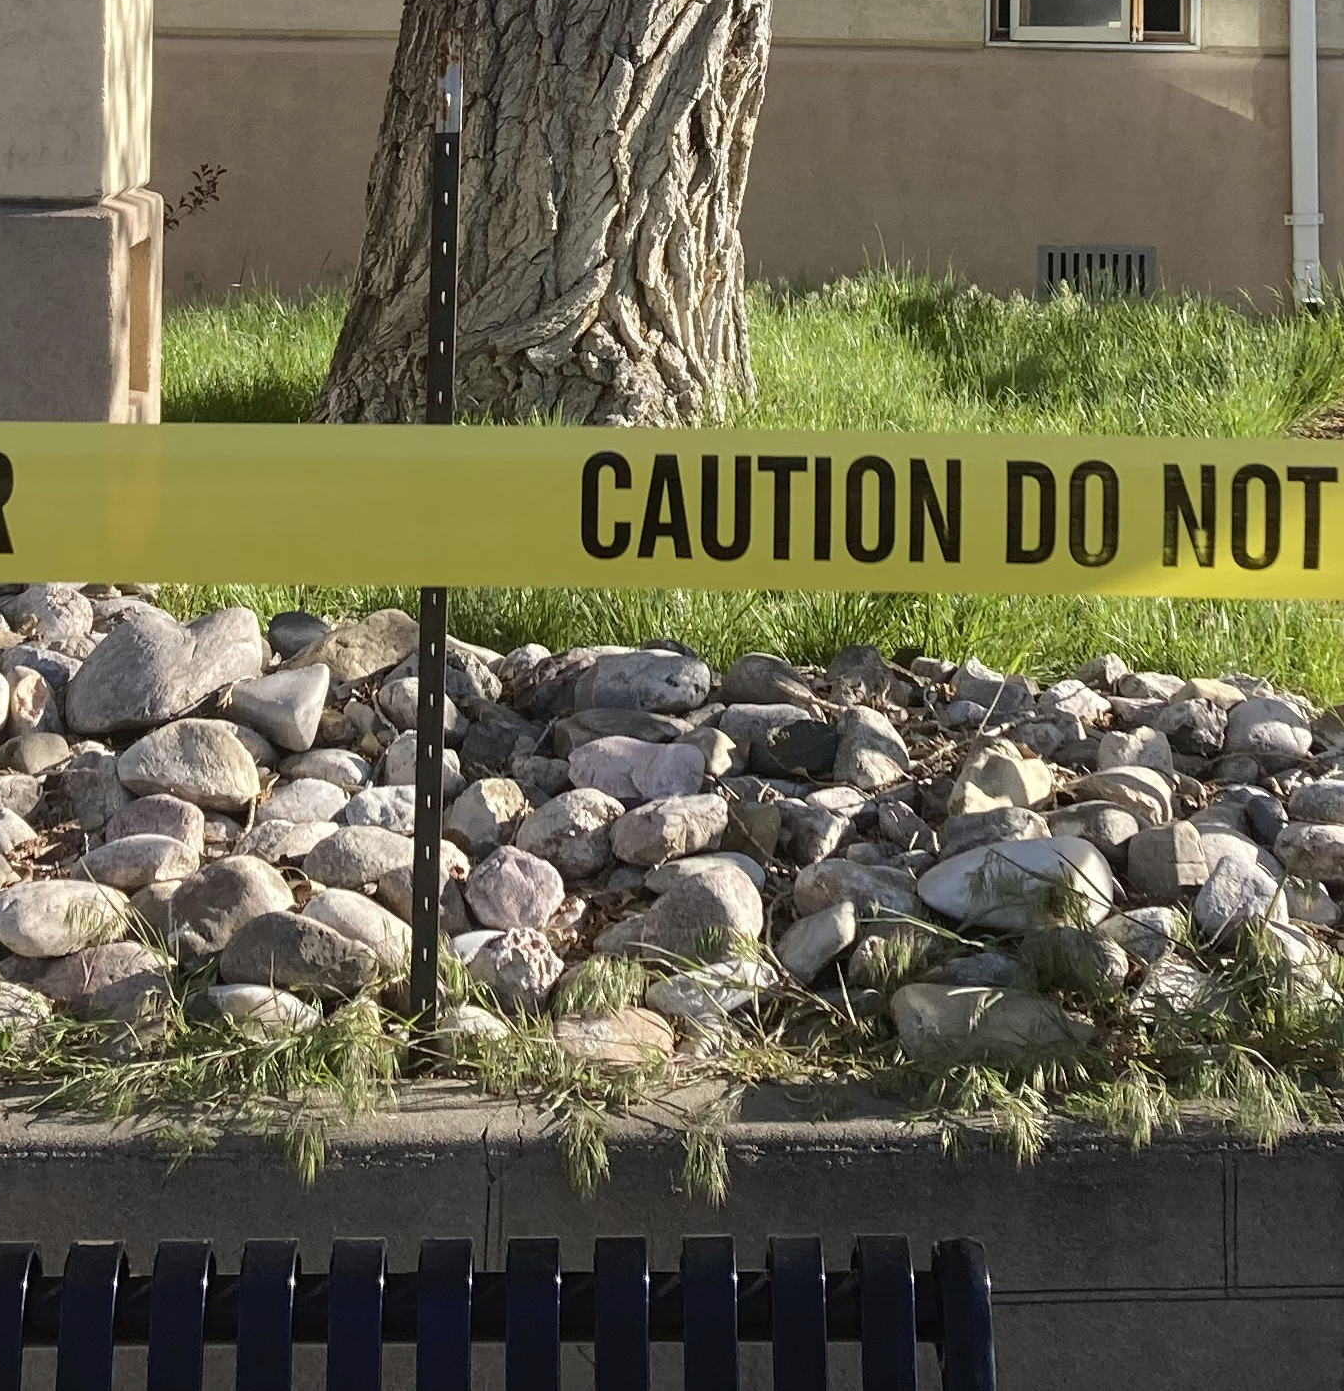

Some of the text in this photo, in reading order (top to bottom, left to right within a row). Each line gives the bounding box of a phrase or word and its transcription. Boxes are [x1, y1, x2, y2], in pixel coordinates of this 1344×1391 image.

[580, 451, 962, 563] CAUTION
[1005, 460, 1120, 568] DO
[1162, 463, 1339, 571] NOT
